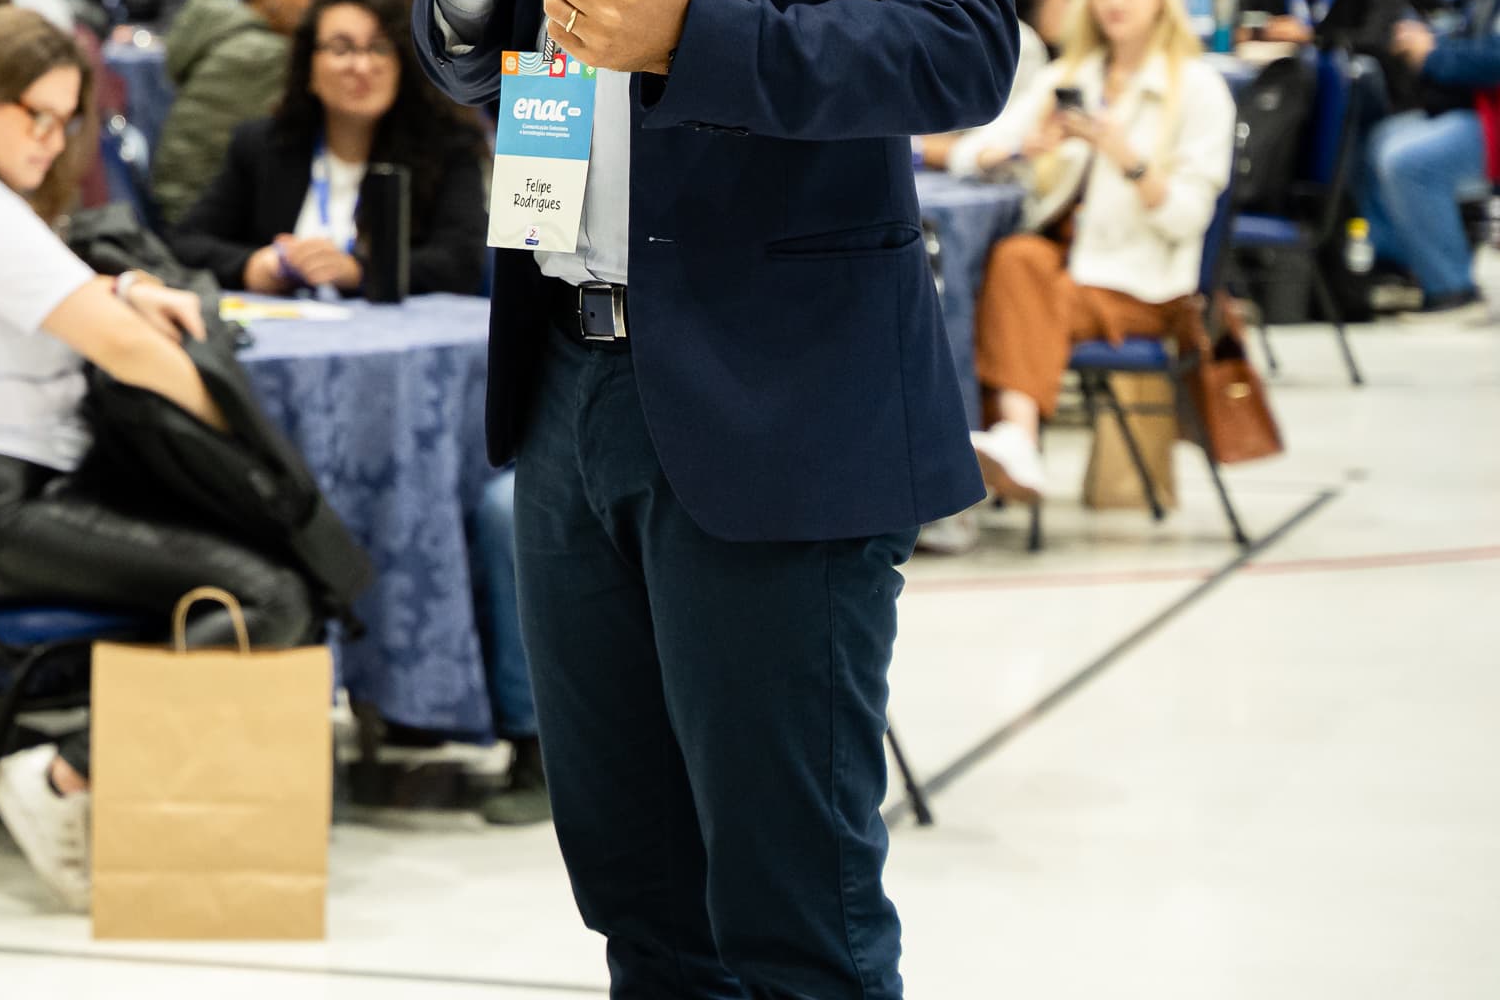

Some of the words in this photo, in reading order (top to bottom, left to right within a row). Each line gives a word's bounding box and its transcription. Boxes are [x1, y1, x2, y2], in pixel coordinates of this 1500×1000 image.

[513, 97, 569, 122] enac
[526, 178, 552, 196] Felipe
[513, 193, 562, 213] Rodrigues
